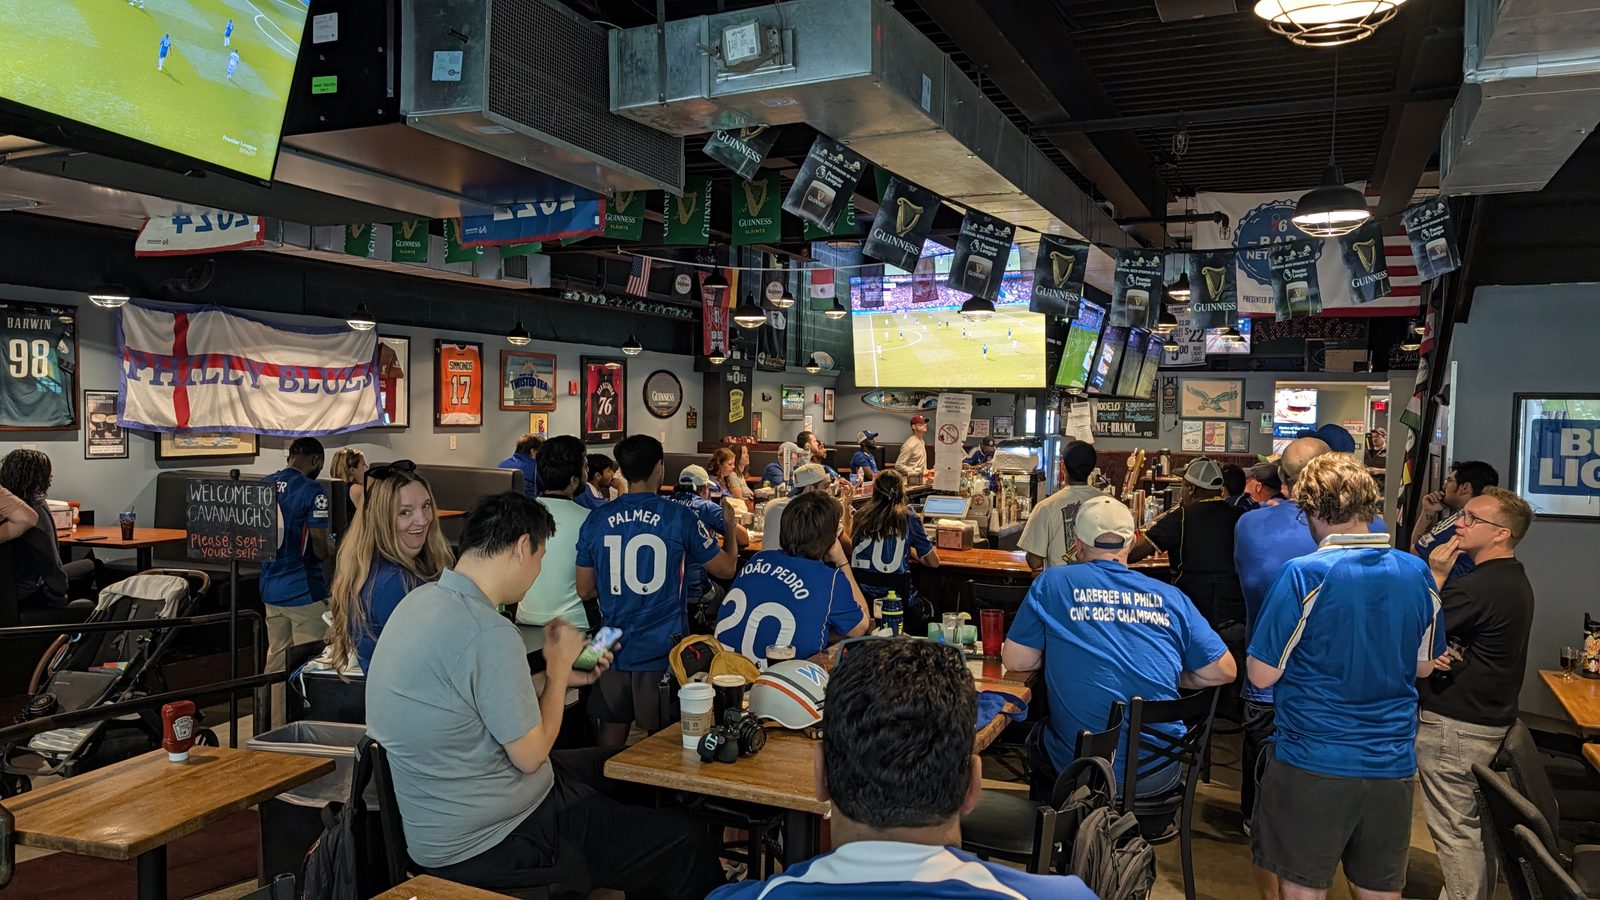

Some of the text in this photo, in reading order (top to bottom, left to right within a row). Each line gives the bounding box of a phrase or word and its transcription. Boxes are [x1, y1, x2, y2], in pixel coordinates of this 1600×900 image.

[240, 141, 257, 151] League
[716, 129, 762, 163] GUINNESS
[825, 176, 842, 188] League
[826, 170, 844, 184] Premier
[702, 180, 712, 237] GUINNESS
[605, 212, 636, 224] GUINNESS
[739, 218, 772, 227] GUINNESS
[1269, 219, 1288, 232] 76
[395, 240, 421, 248] GUINNESS
[873, 228, 920, 255] GUINNESS
[981, 242, 998, 252] Premier
[980, 248, 997, 257] League
[1352, 270, 1388, 288] GUINNESS
[1035, 285, 1079, 301] GUINNESS
[1243, 295, 1267, 304] PRESENTED
[1194, 303, 1236, 312] GUINNESS
[7, 318, 51, 330] BARWIN
[9, 339, 50, 378] 98
[449, 361, 473, 370] SIMMONDS
[126, 351, 372, 396] PHILLY BLUES
[451, 375, 471, 405] 17
[511, 376, 548, 391] TWISTED TEA
[652, 391, 675, 402] GUINNESS
[598, 397, 613, 415] 76
[190, 484, 252, 505] WELCOME
[257, 486, 273, 506] TO
[188, 505, 272, 528] CAVANAUGH'S
[607, 509, 661, 528] PALMER
[191, 533, 229, 548] Please
[851, 533, 905, 573] 20
[604, 534, 667, 595] 10
[740, 559, 810, 601] JOÃO PEDRO
[1073, 588, 1163, 608] CAREFREE IN PHILLY
[1070, 606, 1170, 627] CWC 2025 CHAMPIONS
[714, 588, 796, 672] 20
